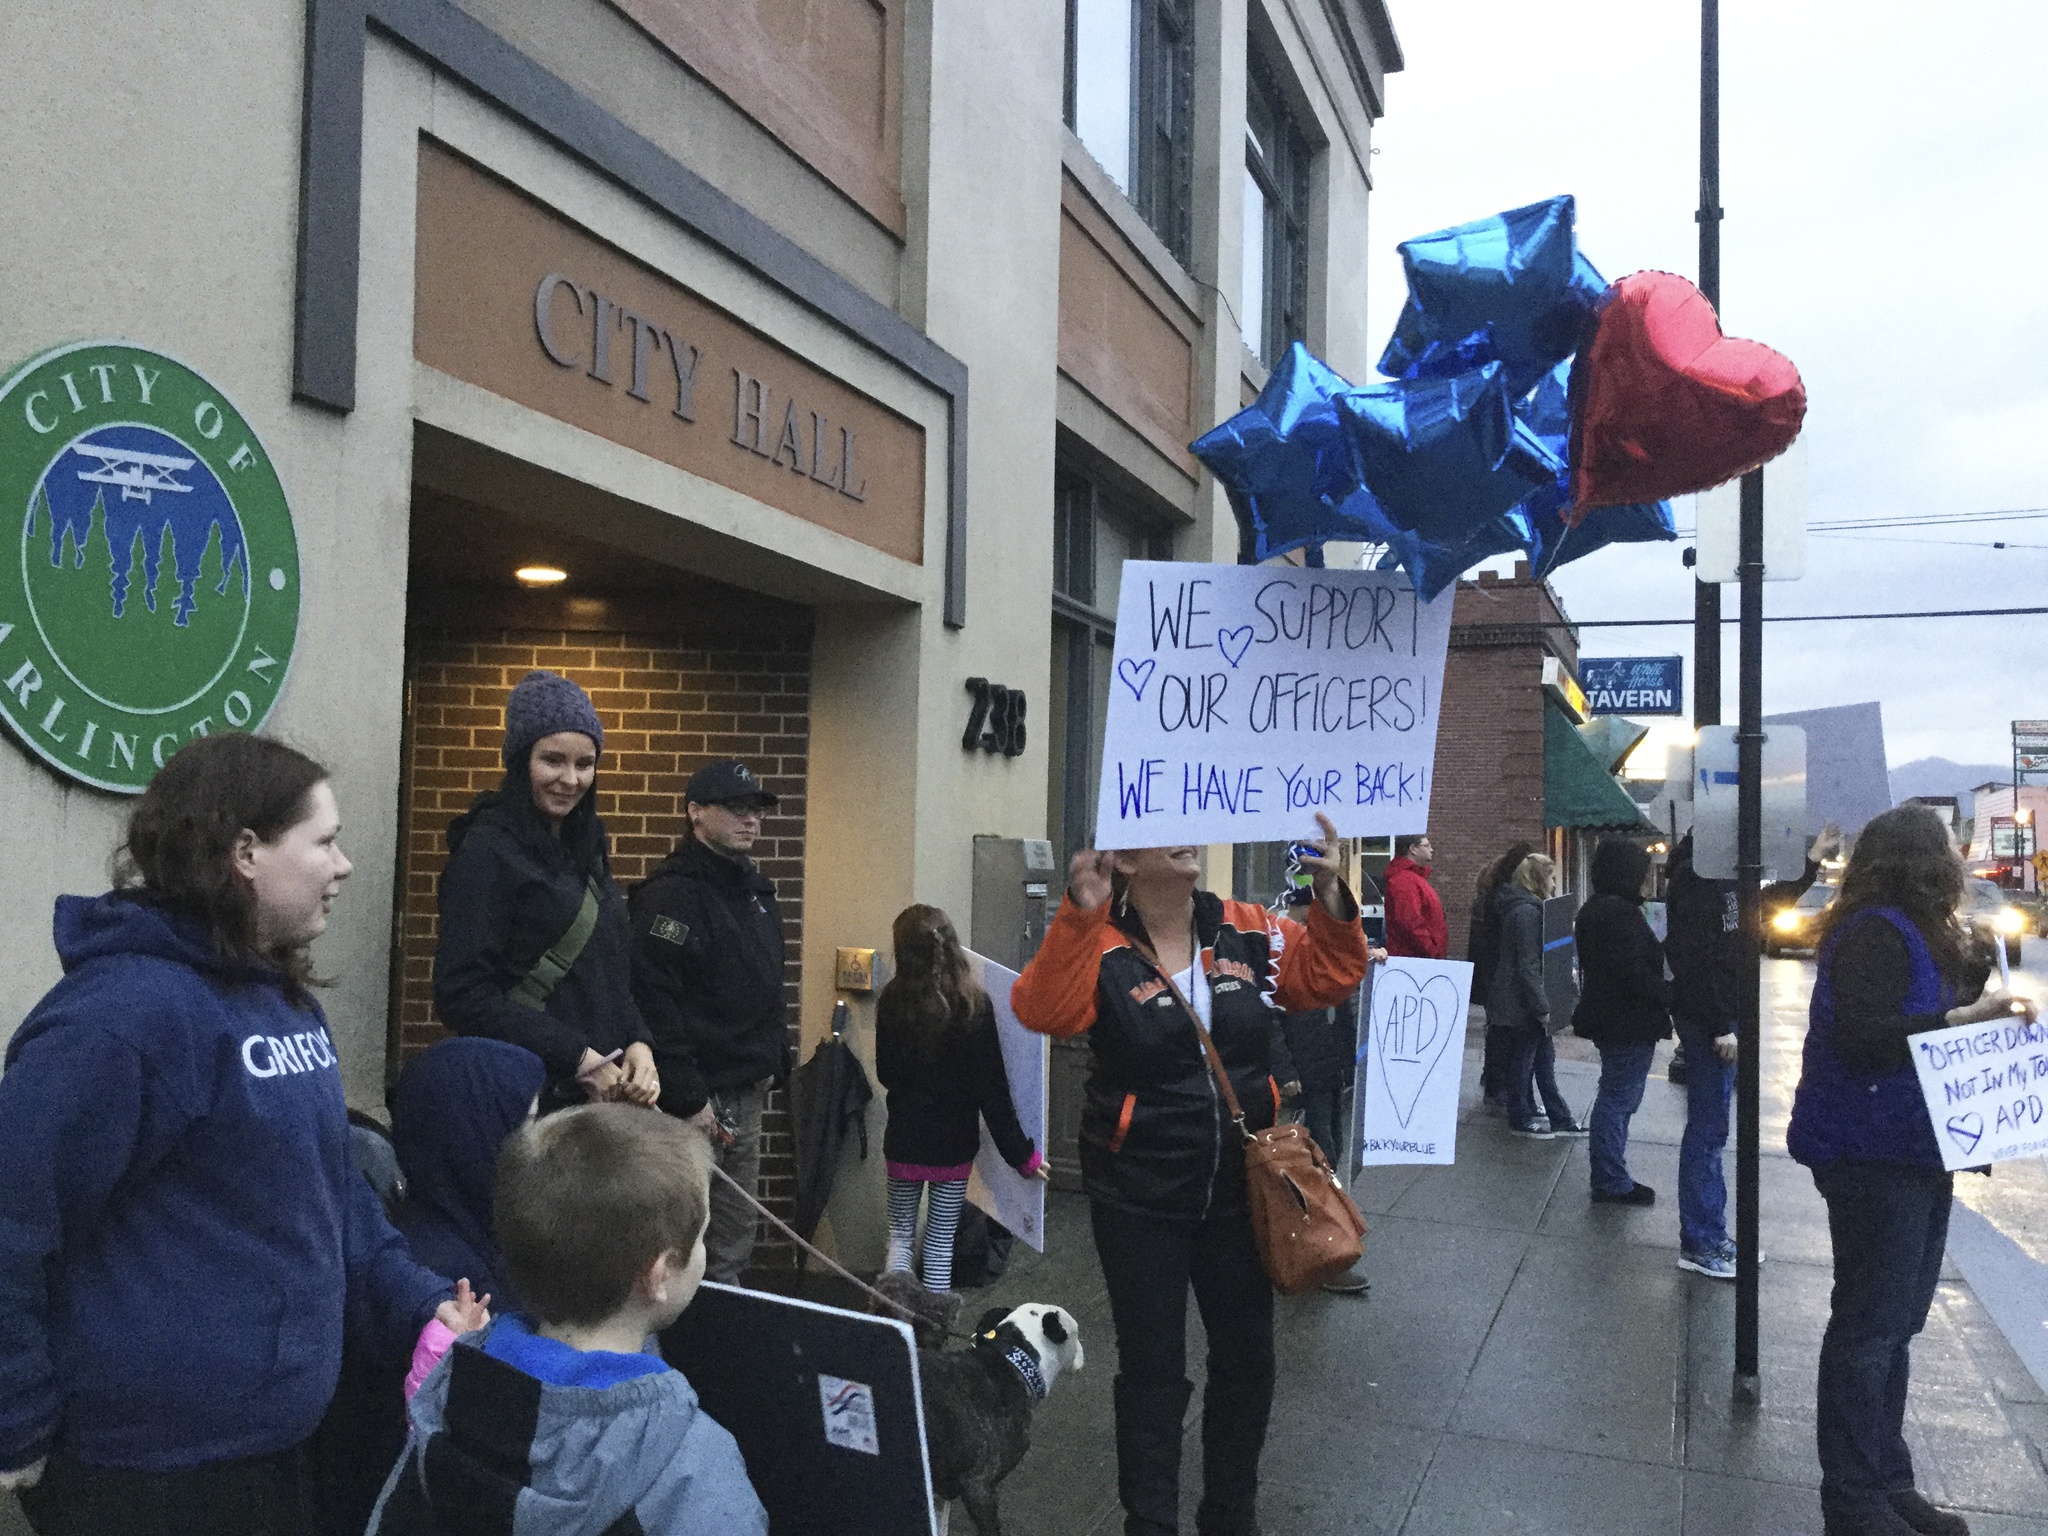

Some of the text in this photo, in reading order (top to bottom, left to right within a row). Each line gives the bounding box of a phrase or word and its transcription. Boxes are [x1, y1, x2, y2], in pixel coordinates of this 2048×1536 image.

[25, 363, 259, 473] CITY OF
[534, 271, 866, 504] CITY HALL
[1149, 580, 1418, 657] WE SUPPORT
[1159, 672, 1427, 733] OUR OFFICERS!
[1585, 689, 1672, 708] TAVERN
[1118, 759, 1425, 819] WE HAVE YOUR BACK!
[1382, 994, 1438, 1055] APD
[1996, 1094, 2044, 1134] APD
